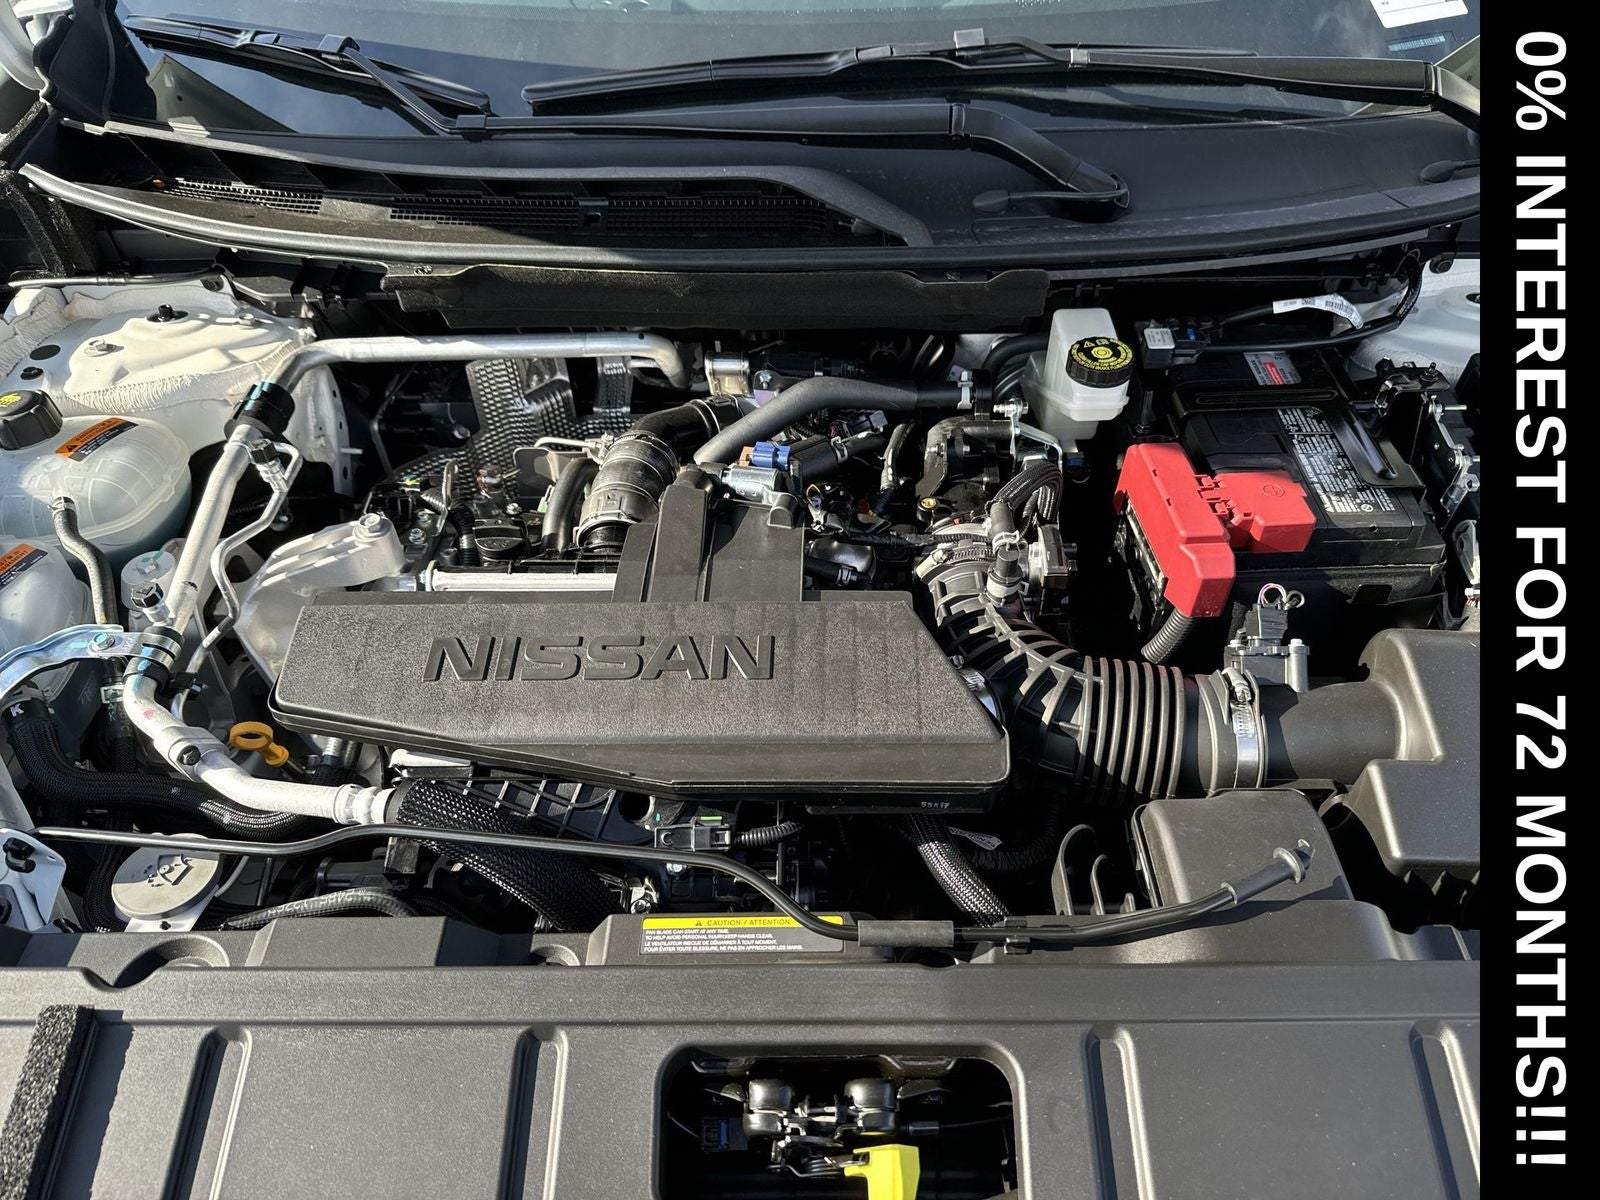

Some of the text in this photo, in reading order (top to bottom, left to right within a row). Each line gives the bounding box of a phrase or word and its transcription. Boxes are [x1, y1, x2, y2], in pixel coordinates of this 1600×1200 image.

[422, 635, 776, 681] NISSAN
[707, 919, 741, 927] CAUTION
[749, 918, 791, 926] ATTENTION
